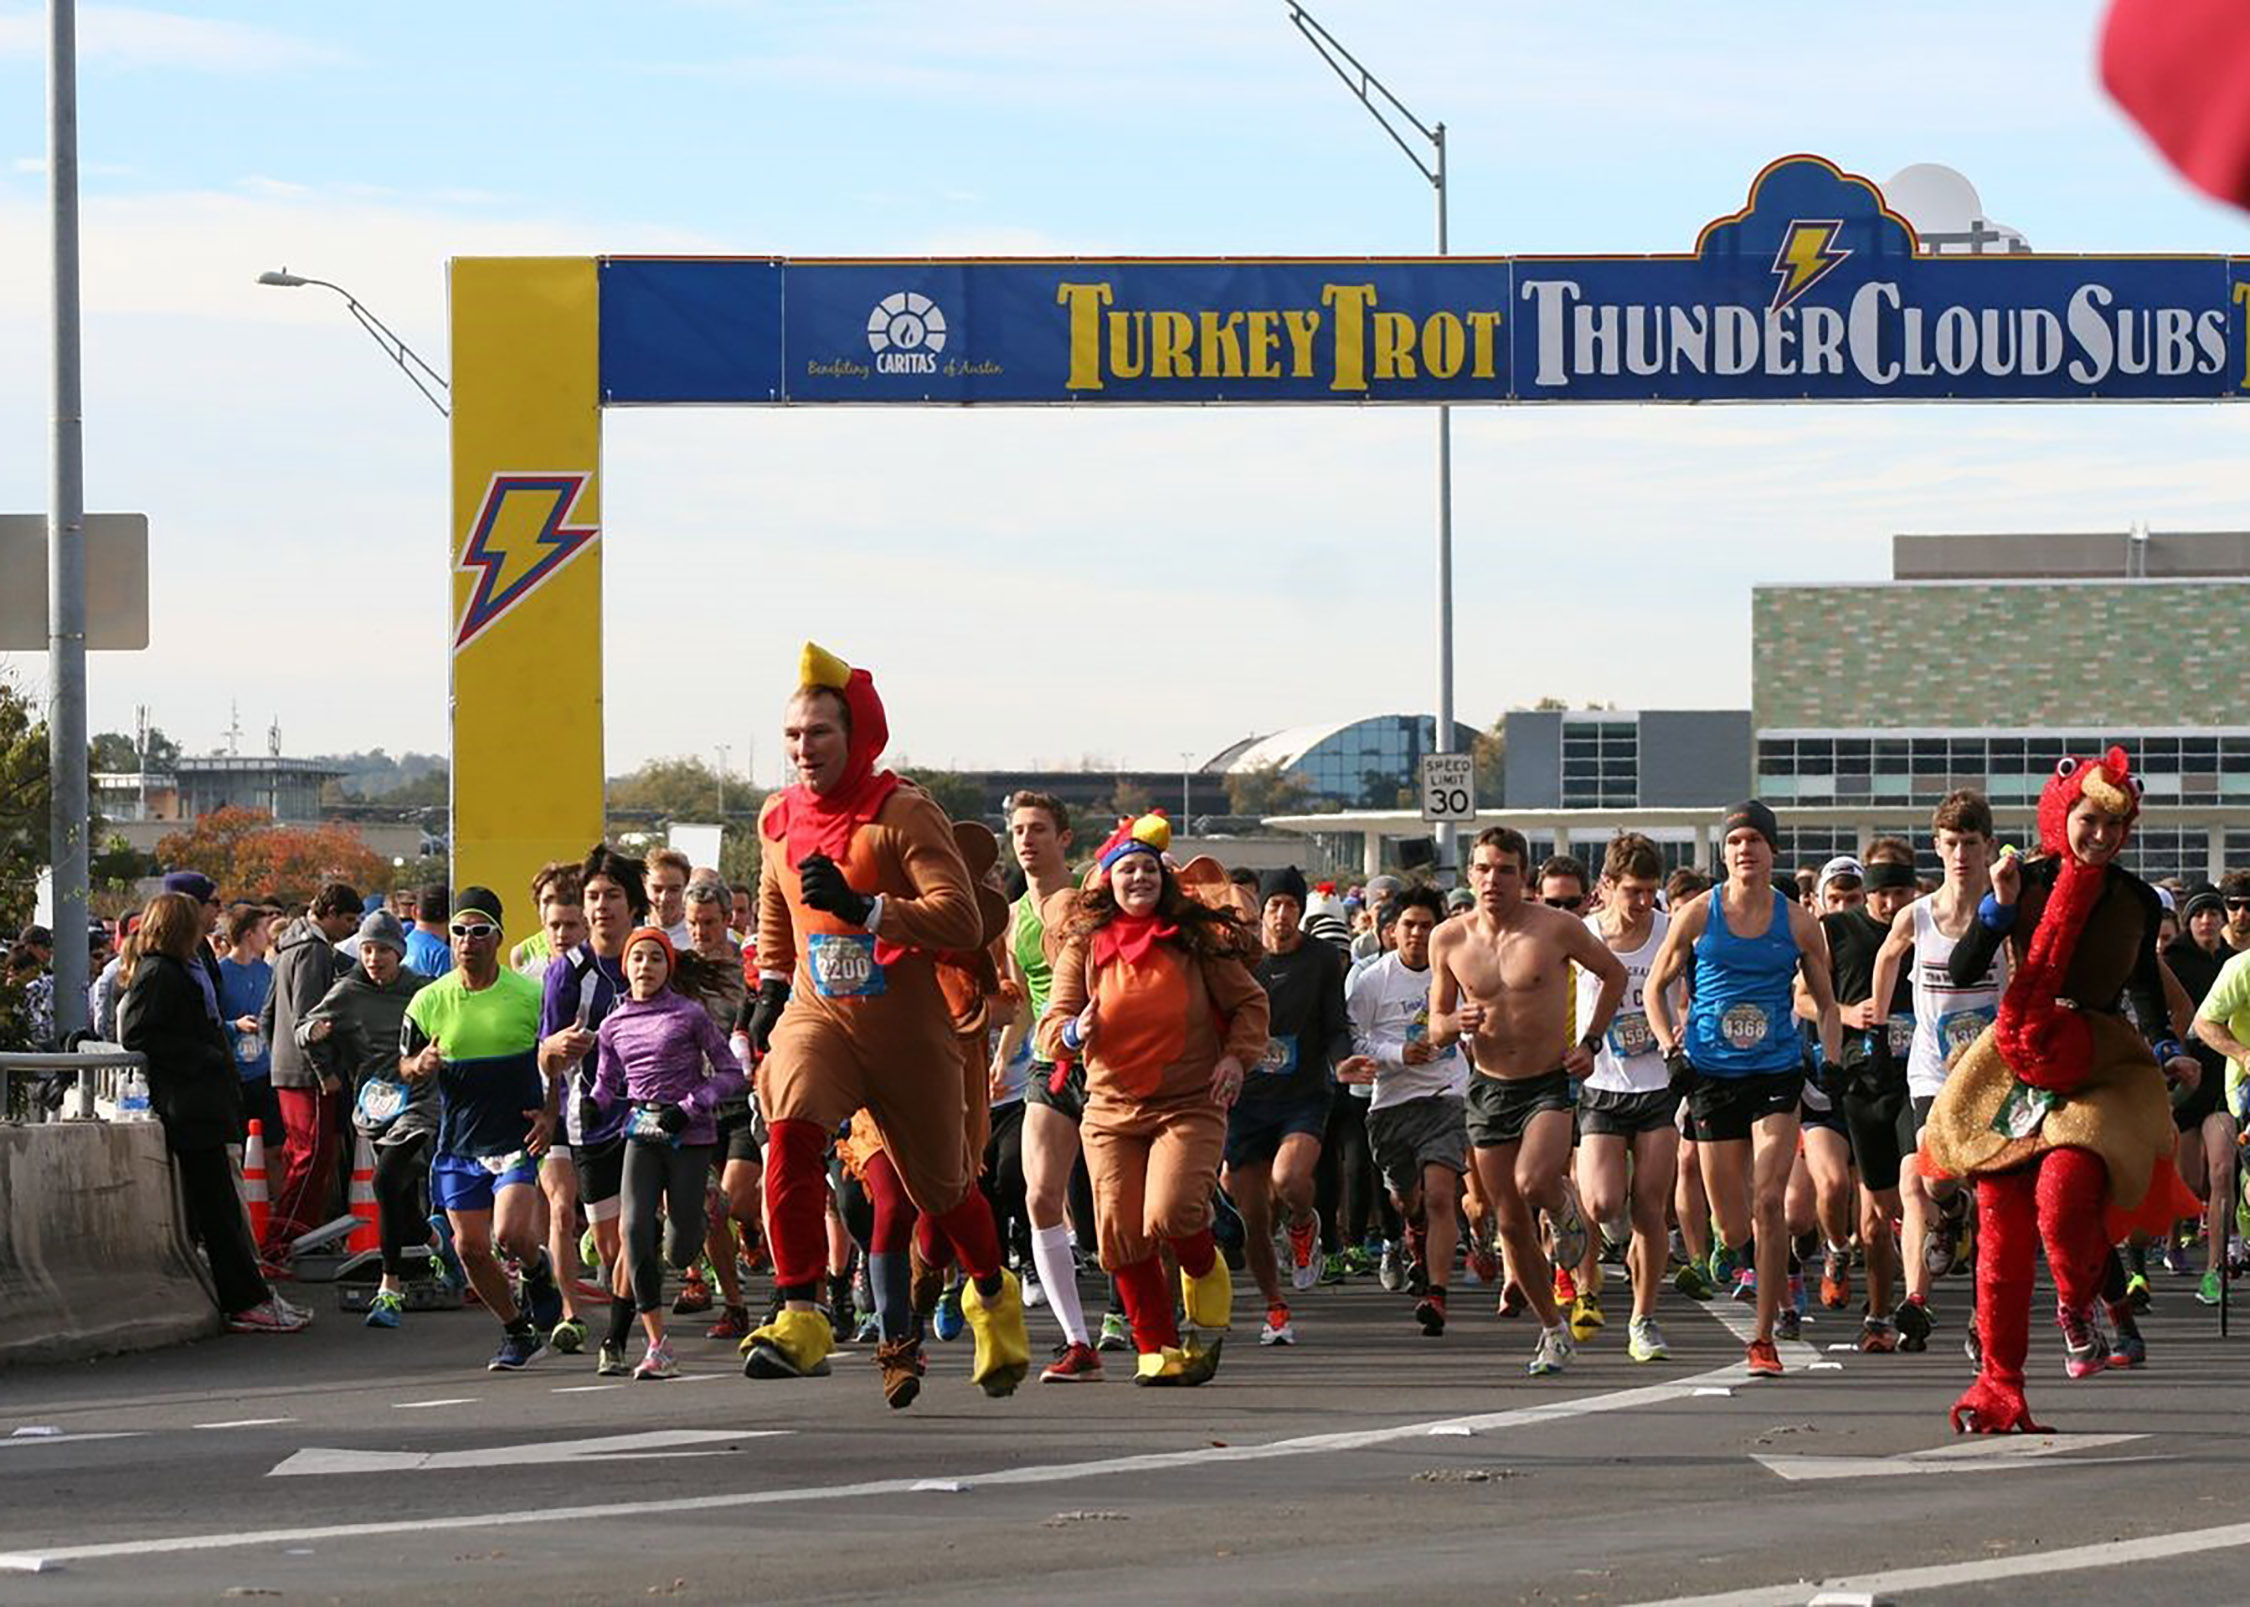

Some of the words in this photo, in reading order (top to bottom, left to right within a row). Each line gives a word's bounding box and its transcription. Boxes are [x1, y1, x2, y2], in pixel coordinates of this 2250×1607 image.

[807, 360, 869, 379] Benefiting
[876, 353, 937, 374] CARITAS
[942, 357, 957, 380] of
[957, 358, 1004, 376] Austin
[1426, 760, 1471, 772] SPEED
[1430, 774, 1465, 786] LIMIT
[1430, 788, 1469, 814] 30
